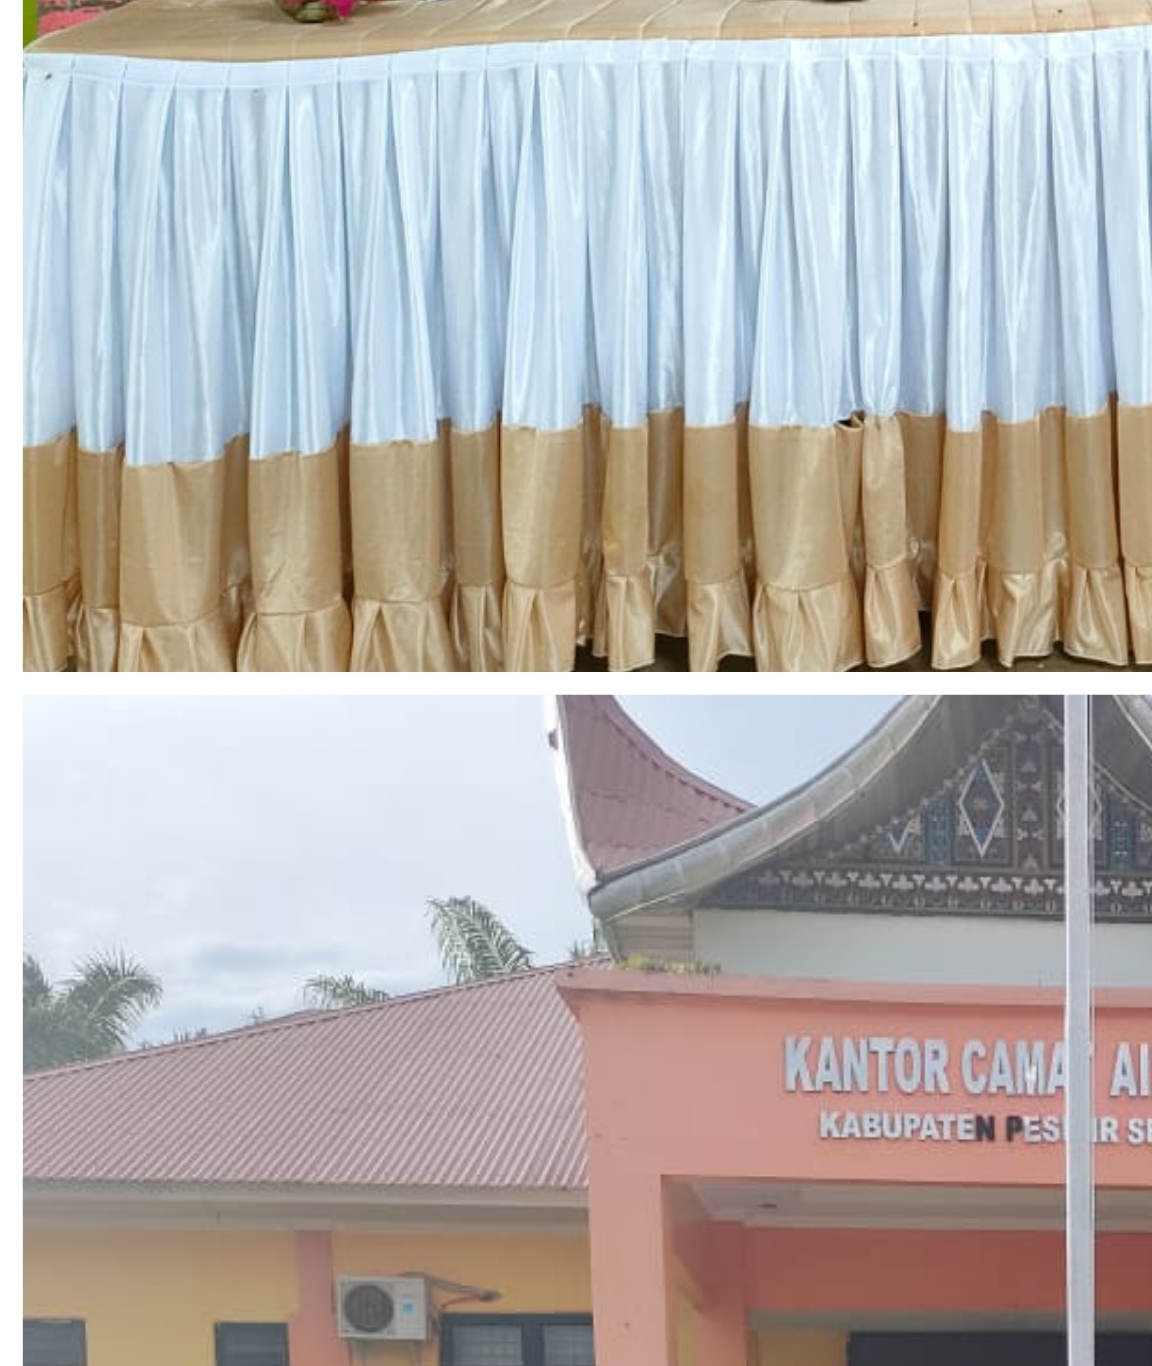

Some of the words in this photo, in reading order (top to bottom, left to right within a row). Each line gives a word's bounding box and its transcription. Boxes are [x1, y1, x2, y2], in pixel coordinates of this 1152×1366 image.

[785, 1035, 951, 1095] KANTOR
[960, 1039, 1092, 1097] CAMA
[818, 1110, 996, 1142] KABUPATEN
[1005, 1115, 1120, 1147] PESIR
